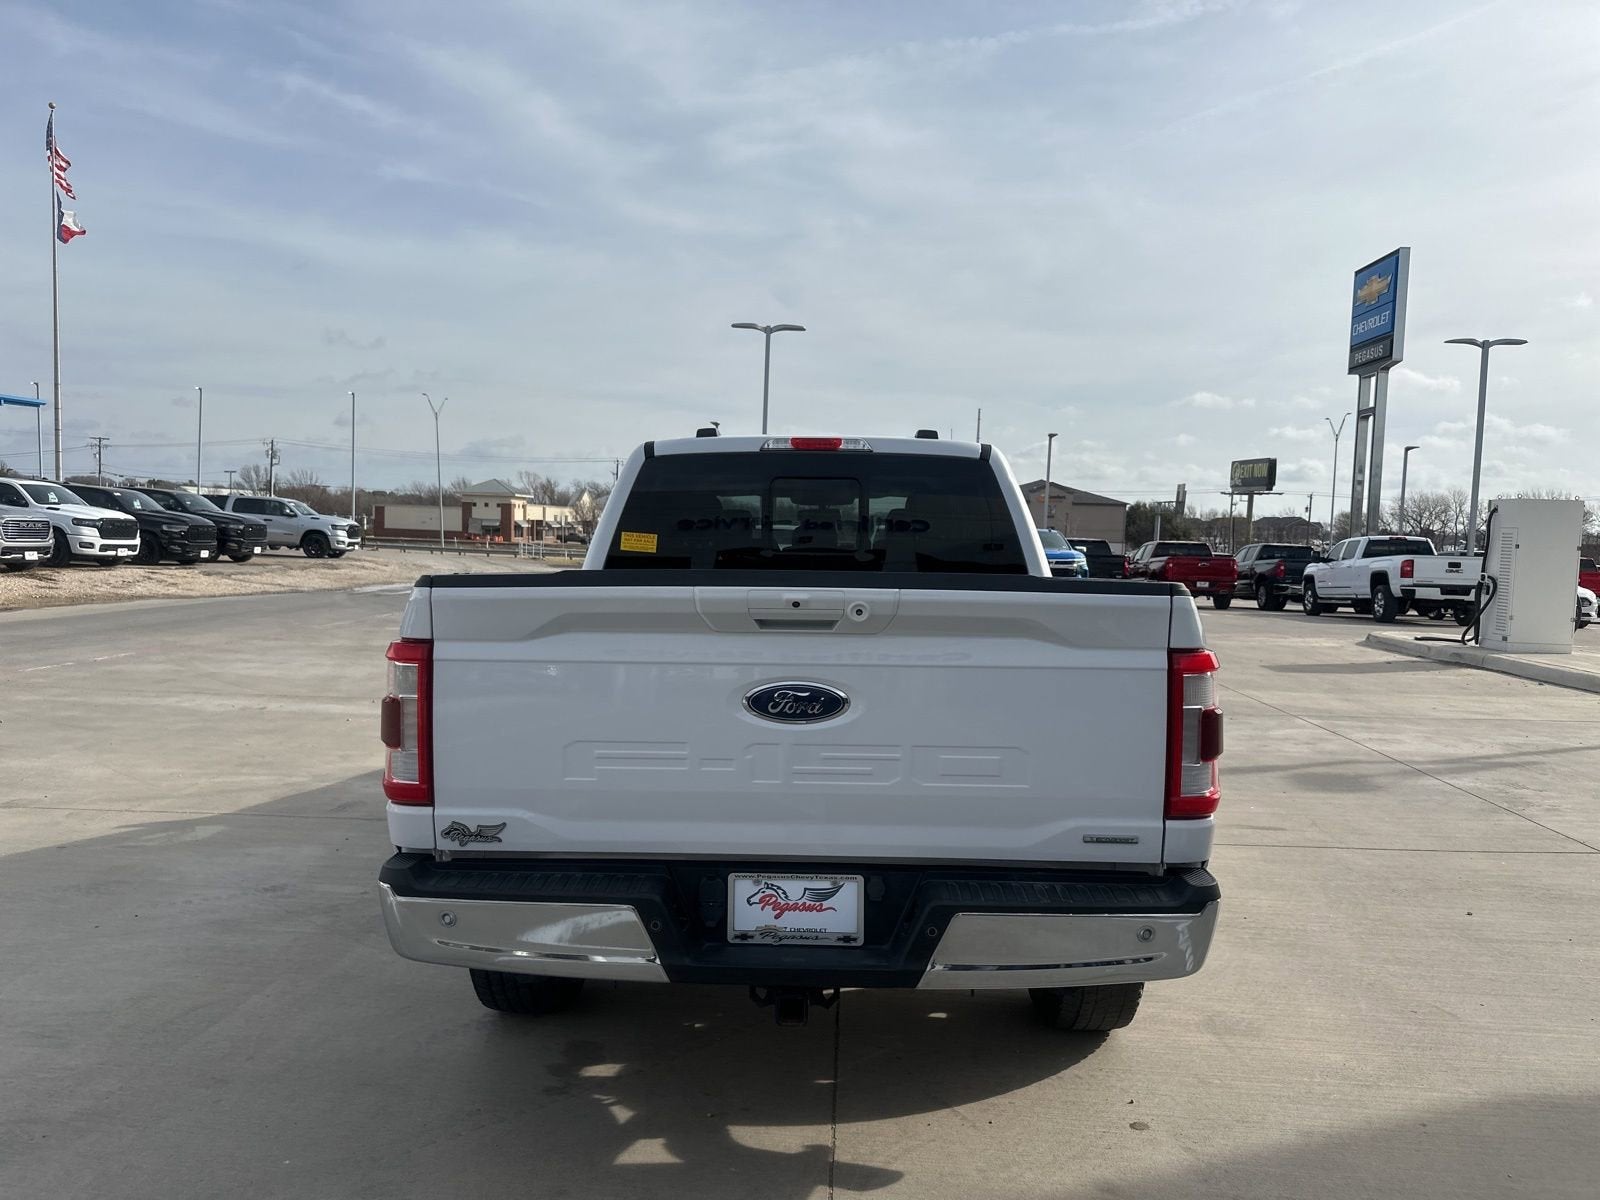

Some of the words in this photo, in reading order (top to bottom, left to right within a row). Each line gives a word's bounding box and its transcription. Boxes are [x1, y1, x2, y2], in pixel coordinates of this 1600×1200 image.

[1352, 311, 1390, 336] CHEVROLET
[1354, 345, 1384, 364] PEGASUS
[1240, 464, 1253, 478] EXIT
[1254, 463, 1269, 477] NOW
[19, 521, 43, 530] RAM
[767, 690, 825, 715] Ford
[562, 739, 1031, 789] F-150
[449, 831, 502, 847] Pegasus
[759, 893, 837, 920] Pegasus
[759, 931, 831, 944] Pegasus
